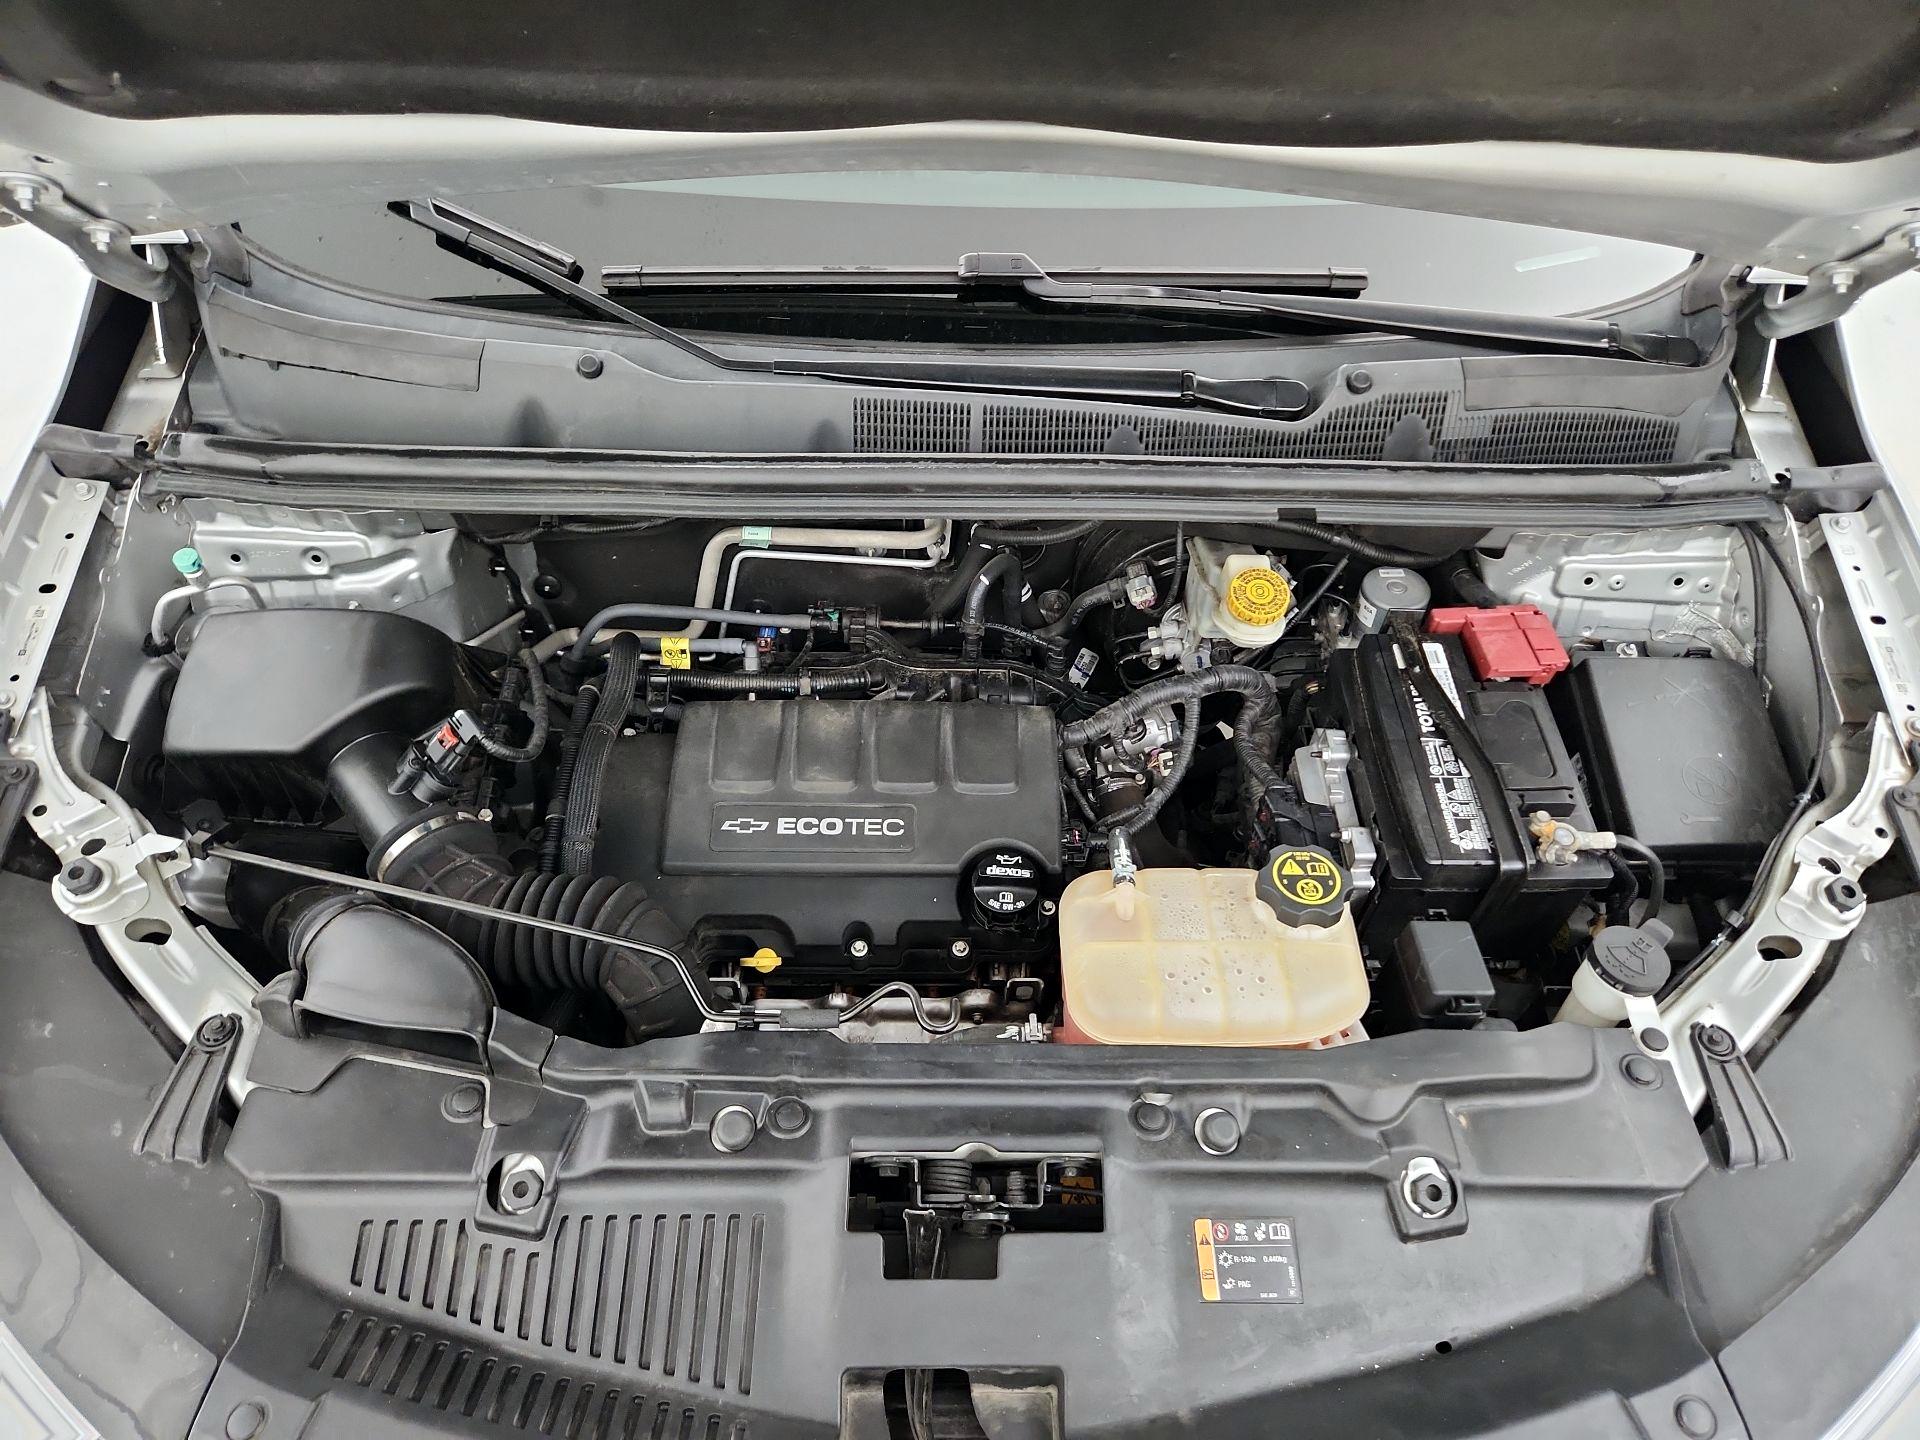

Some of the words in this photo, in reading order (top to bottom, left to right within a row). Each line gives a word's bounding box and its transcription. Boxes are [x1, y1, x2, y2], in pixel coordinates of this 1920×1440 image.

[776, 817, 905, 836] ECOTEC
[986, 865, 1031, 877] dexos
[988, 898, 1002, 910] SAE
[1002, 900, 1026, 911] 5W-30
